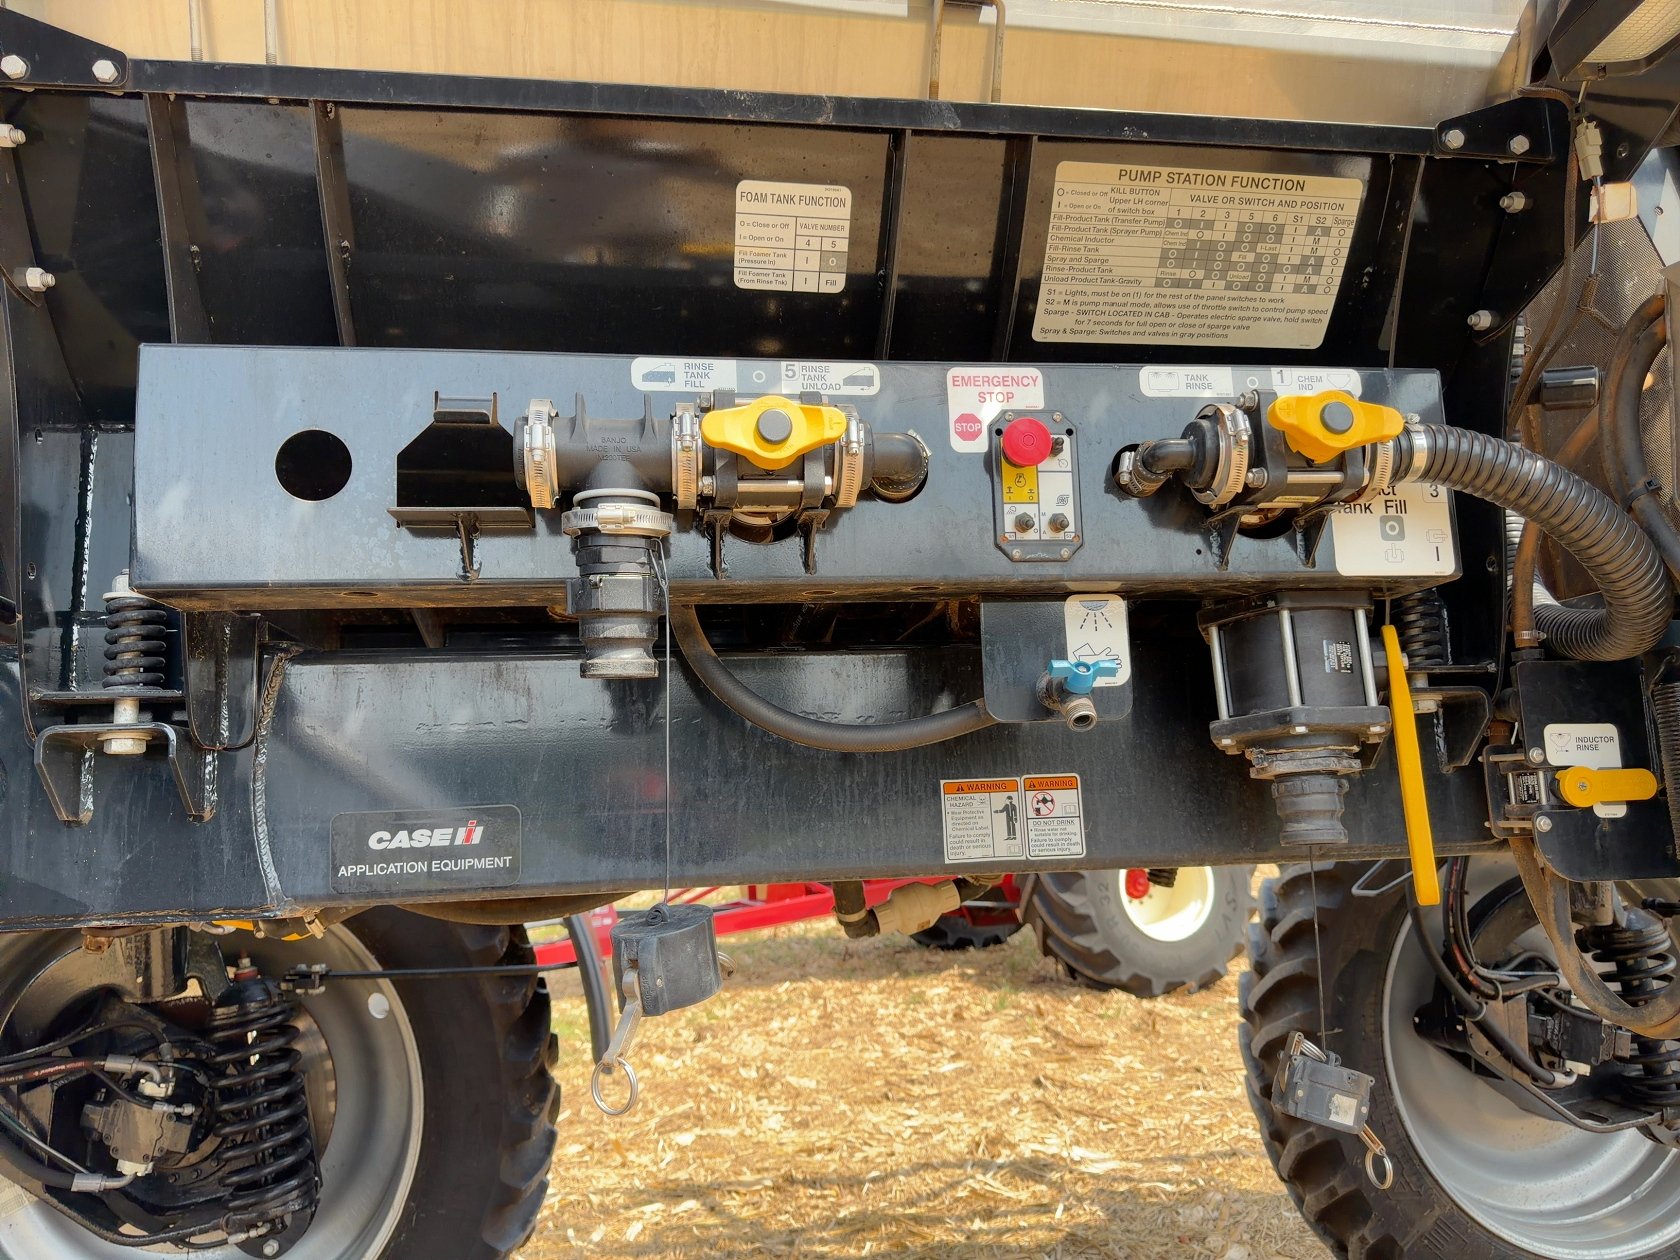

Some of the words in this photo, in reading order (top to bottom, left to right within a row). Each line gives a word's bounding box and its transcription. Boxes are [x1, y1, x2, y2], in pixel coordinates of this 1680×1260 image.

[1119, 169, 1161, 182] PUMP
[1167, 172, 1226, 186] STATION
[1231, 176, 1305, 191] FUNCTION
[1130, 188, 1160, 196] BUTTON
[740, 192, 767, 203] FOAM
[770, 194, 796, 205] TANK
[799, 195, 846, 208] FUNCTION
[1110, 197, 1131, 205] Upper
[1190, 195, 1218, 203] VALVE
[1222, 196, 1235, 204] OR
[1239, 198, 1274, 207] SWITCH
[1278, 200, 1297, 208] AND
[1300, 201, 1344, 211] POSITION
[1053, 214, 1092, 223] Fill-Product
[1112, 216, 1141, 224] (Transfer
[1143, 218, 1165, 227] Pump)
[1200, 209, 1206, 217] 2
[1272, 214, 1278, 222] 6
[1293, 215, 1303, 223] S1
[1334, 217, 1354, 225] Sparge
[1110, 227, 1138, 235] (Sprayer
[1140, 229, 1162, 237] Pump)
[1046, 265, 1096, 273] Rinse-Product
[1065, 289, 1089, 297] Lights,
[1133, 291, 1141, 299] (1)
[1206, 294, 1225, 302] panel
[1227, 295, 1257, 303] switches
[1069, 328, 1097, 336] Sparge:
[684, 363, 714, 371] RINSE
[785, 364, 796, 379] 5
[684, 371, 710, 379] TANK
[802, 374, 827, 382] TANK
[1277, 370, 1284, 384] 1
[684, 380, 705, 388] FILL
[952, 375, 1039, 387] EMERGENCY
[1186, 382, 1213, 390] RINSE
[802, 383, 841, 391] UNLOAD
[978, 392, 1014, 403] STOP
[955, 423, 981, 431] STOP
[1430, 484, 1439, 497] 3
[1384, 500, 1407, 514] Fill
[967, 783, 1007, 791] WARNING
[368, 828, 453, 850] CASE
[338, 861, 427, 877] APPLICATION
[432, 856, 512, 872] EQUIPMENT
